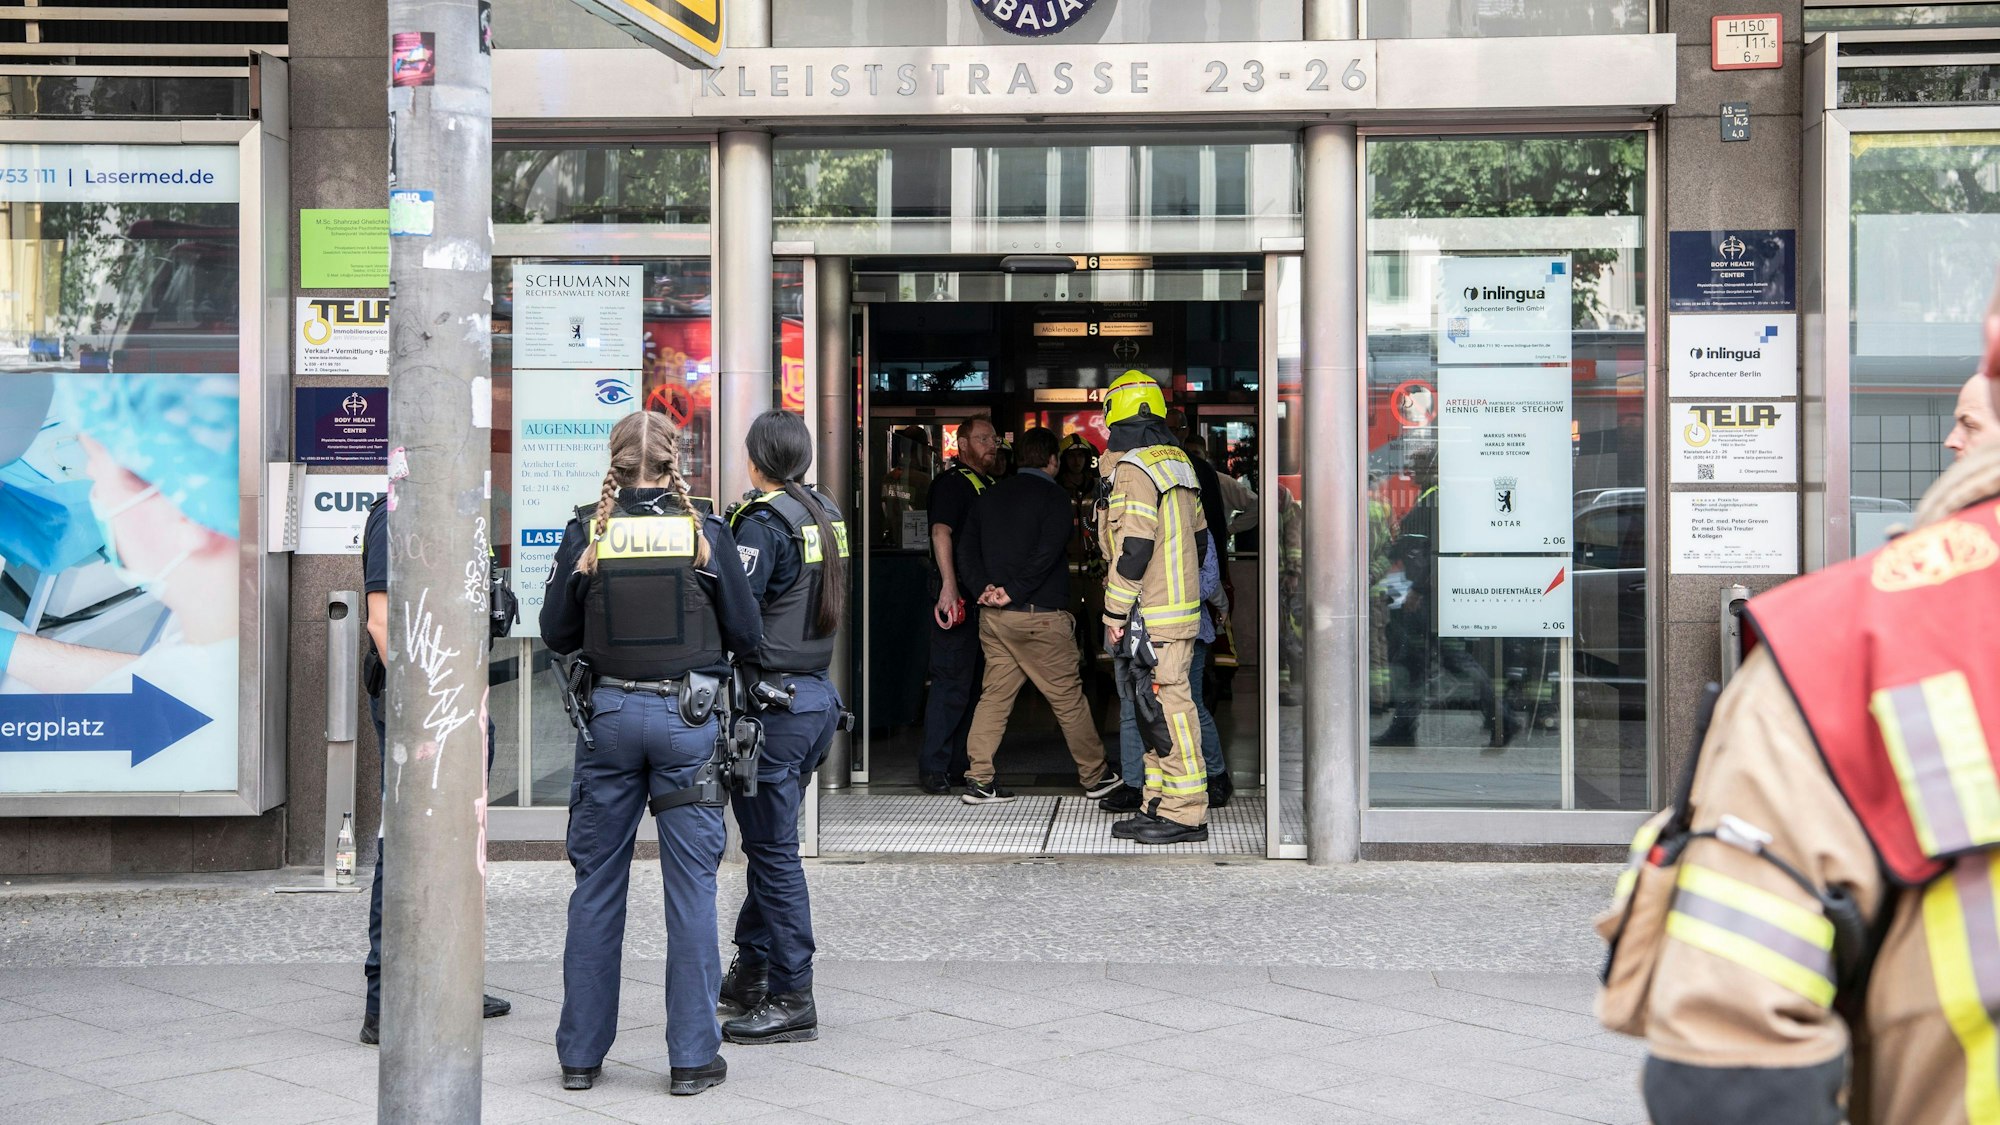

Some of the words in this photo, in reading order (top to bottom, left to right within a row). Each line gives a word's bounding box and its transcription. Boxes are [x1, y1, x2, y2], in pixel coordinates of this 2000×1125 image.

[1729, 20, 1765, 33] H150
[701, 62, 1149, 98] KLEISTSTRASSE
[1722, 106, 1733, 115] AS
[85, 168, 214, 185] Lasermed.de
[1088, 256, 1098, 269] 6
[525, 274, 630, 288] SCHUMANN
[525, 289, 594, 297] RECHTSANWÄLTE
[1482, 285, 1545, 303] inlingua
[1088, 323, 1098, 335] 5
[335, 348, 374, 356] Vermittlung
[1706, 347, 1760, 362] inlingua
[1739, 370, 1762, 378] Berlin
[1088, 389, 1098, 402] 4
[1521, 405, 1564, 413] STECHOW
[520, 444, 536, 452] AM
[1543, 537, 1551, 545] 2.
[1552, 537, 1566, 545] OG
[1451, 587, 1489, 595] WILLIBALD
[1490, 586, 1542, 595] DIEFENTHÄLER
[1542, 621, 1551, 630] 2.
[1552, 621, 1565, 630] OG
